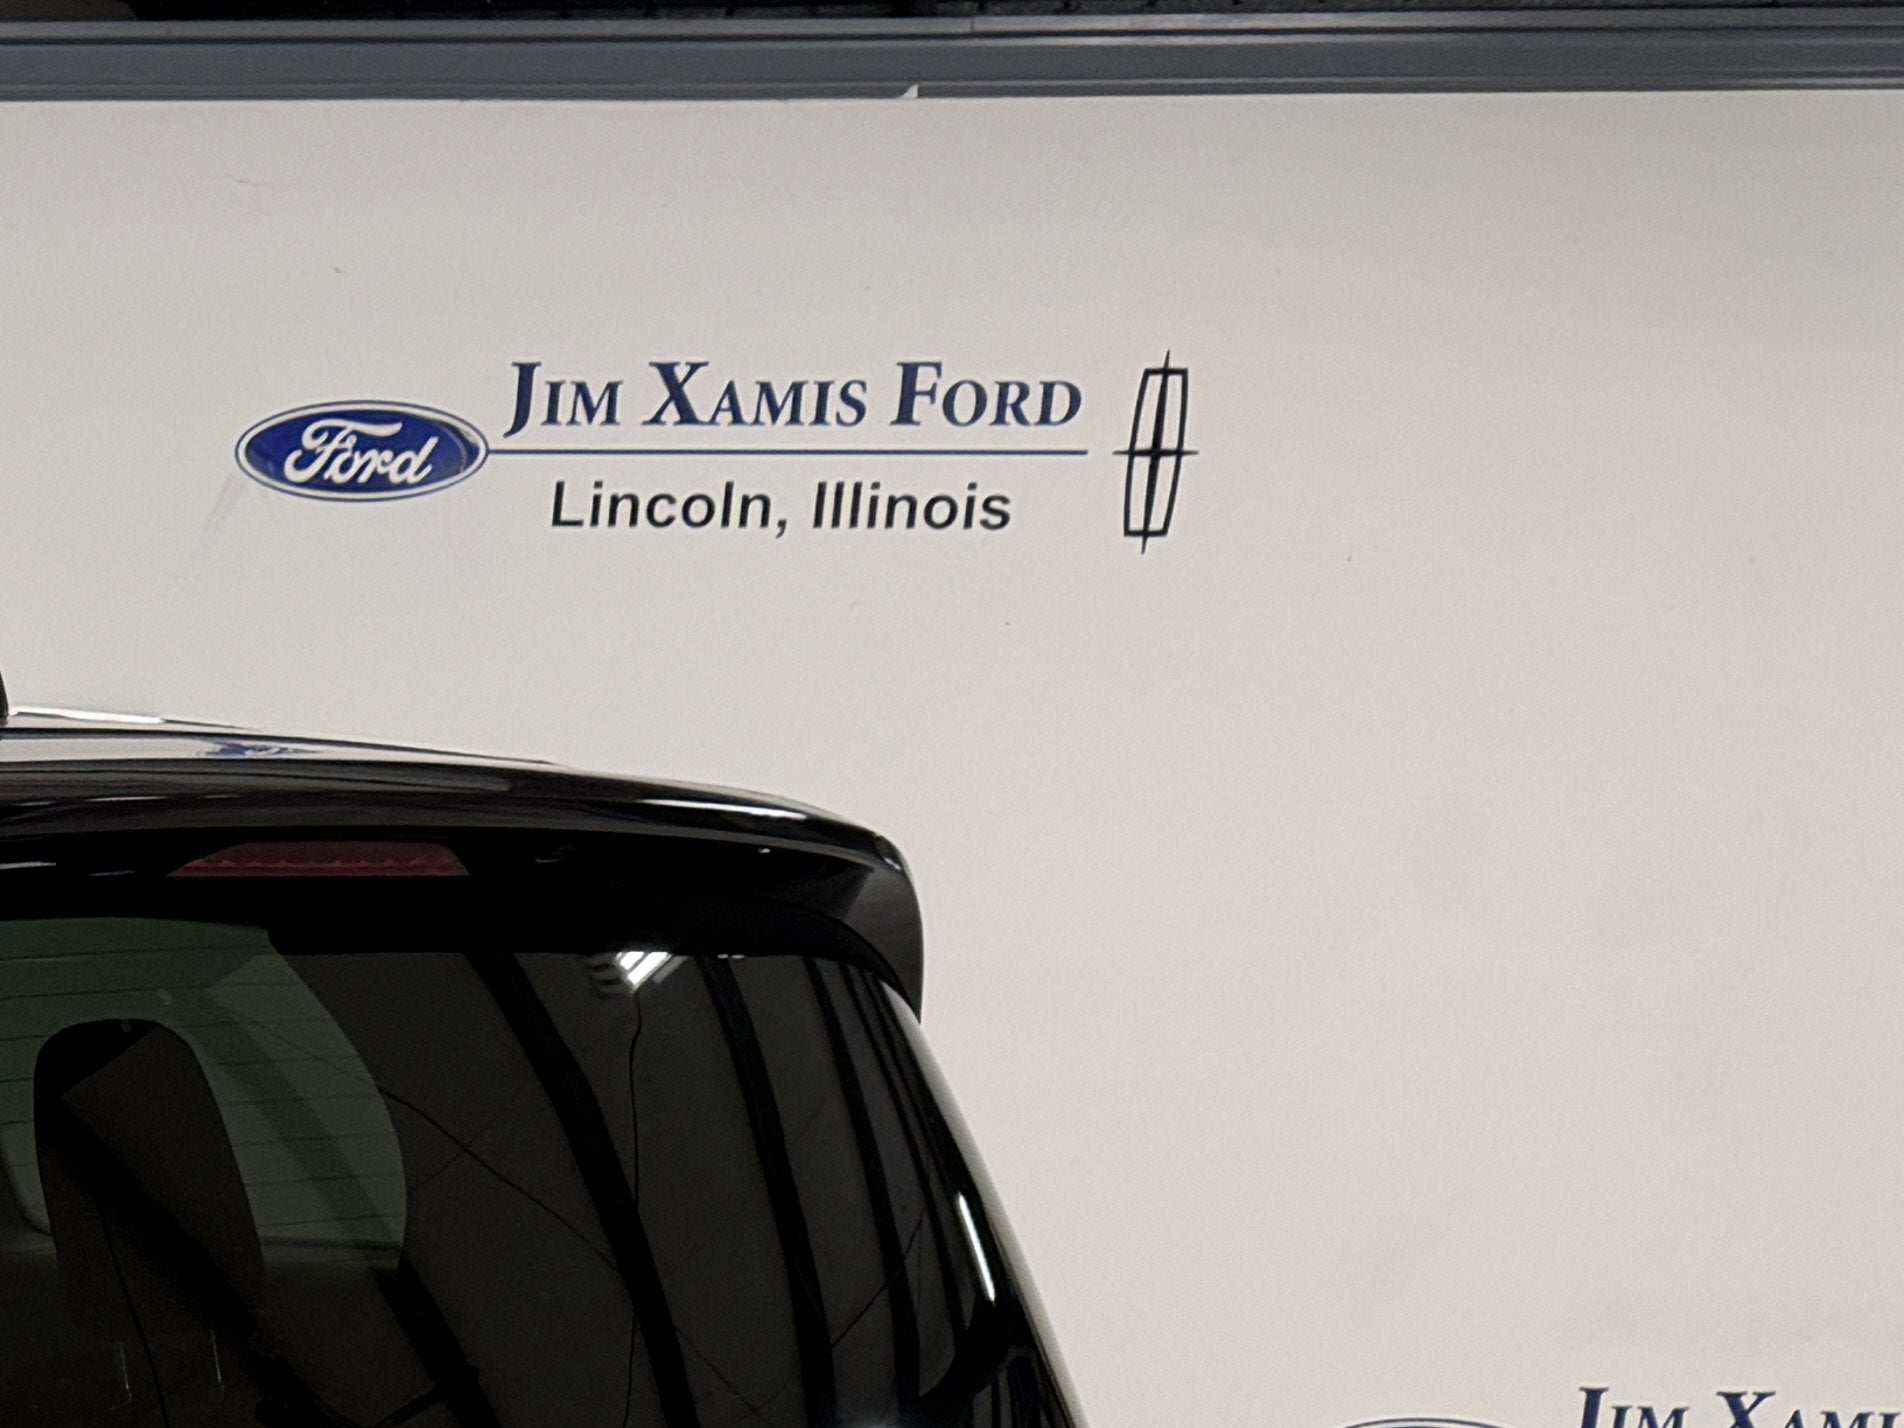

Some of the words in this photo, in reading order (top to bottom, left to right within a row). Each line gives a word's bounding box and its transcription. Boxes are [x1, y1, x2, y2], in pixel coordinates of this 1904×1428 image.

[503, 361, 622, 437] JIM
[644, 362, 867, 427] XAMIS
[890, 362, 1082, 427] FORD
[284, 419, 435, 486] Ford
[552, 480, 788, 537] Lincoln,
[812, 482, 1010, 530] Illinois
